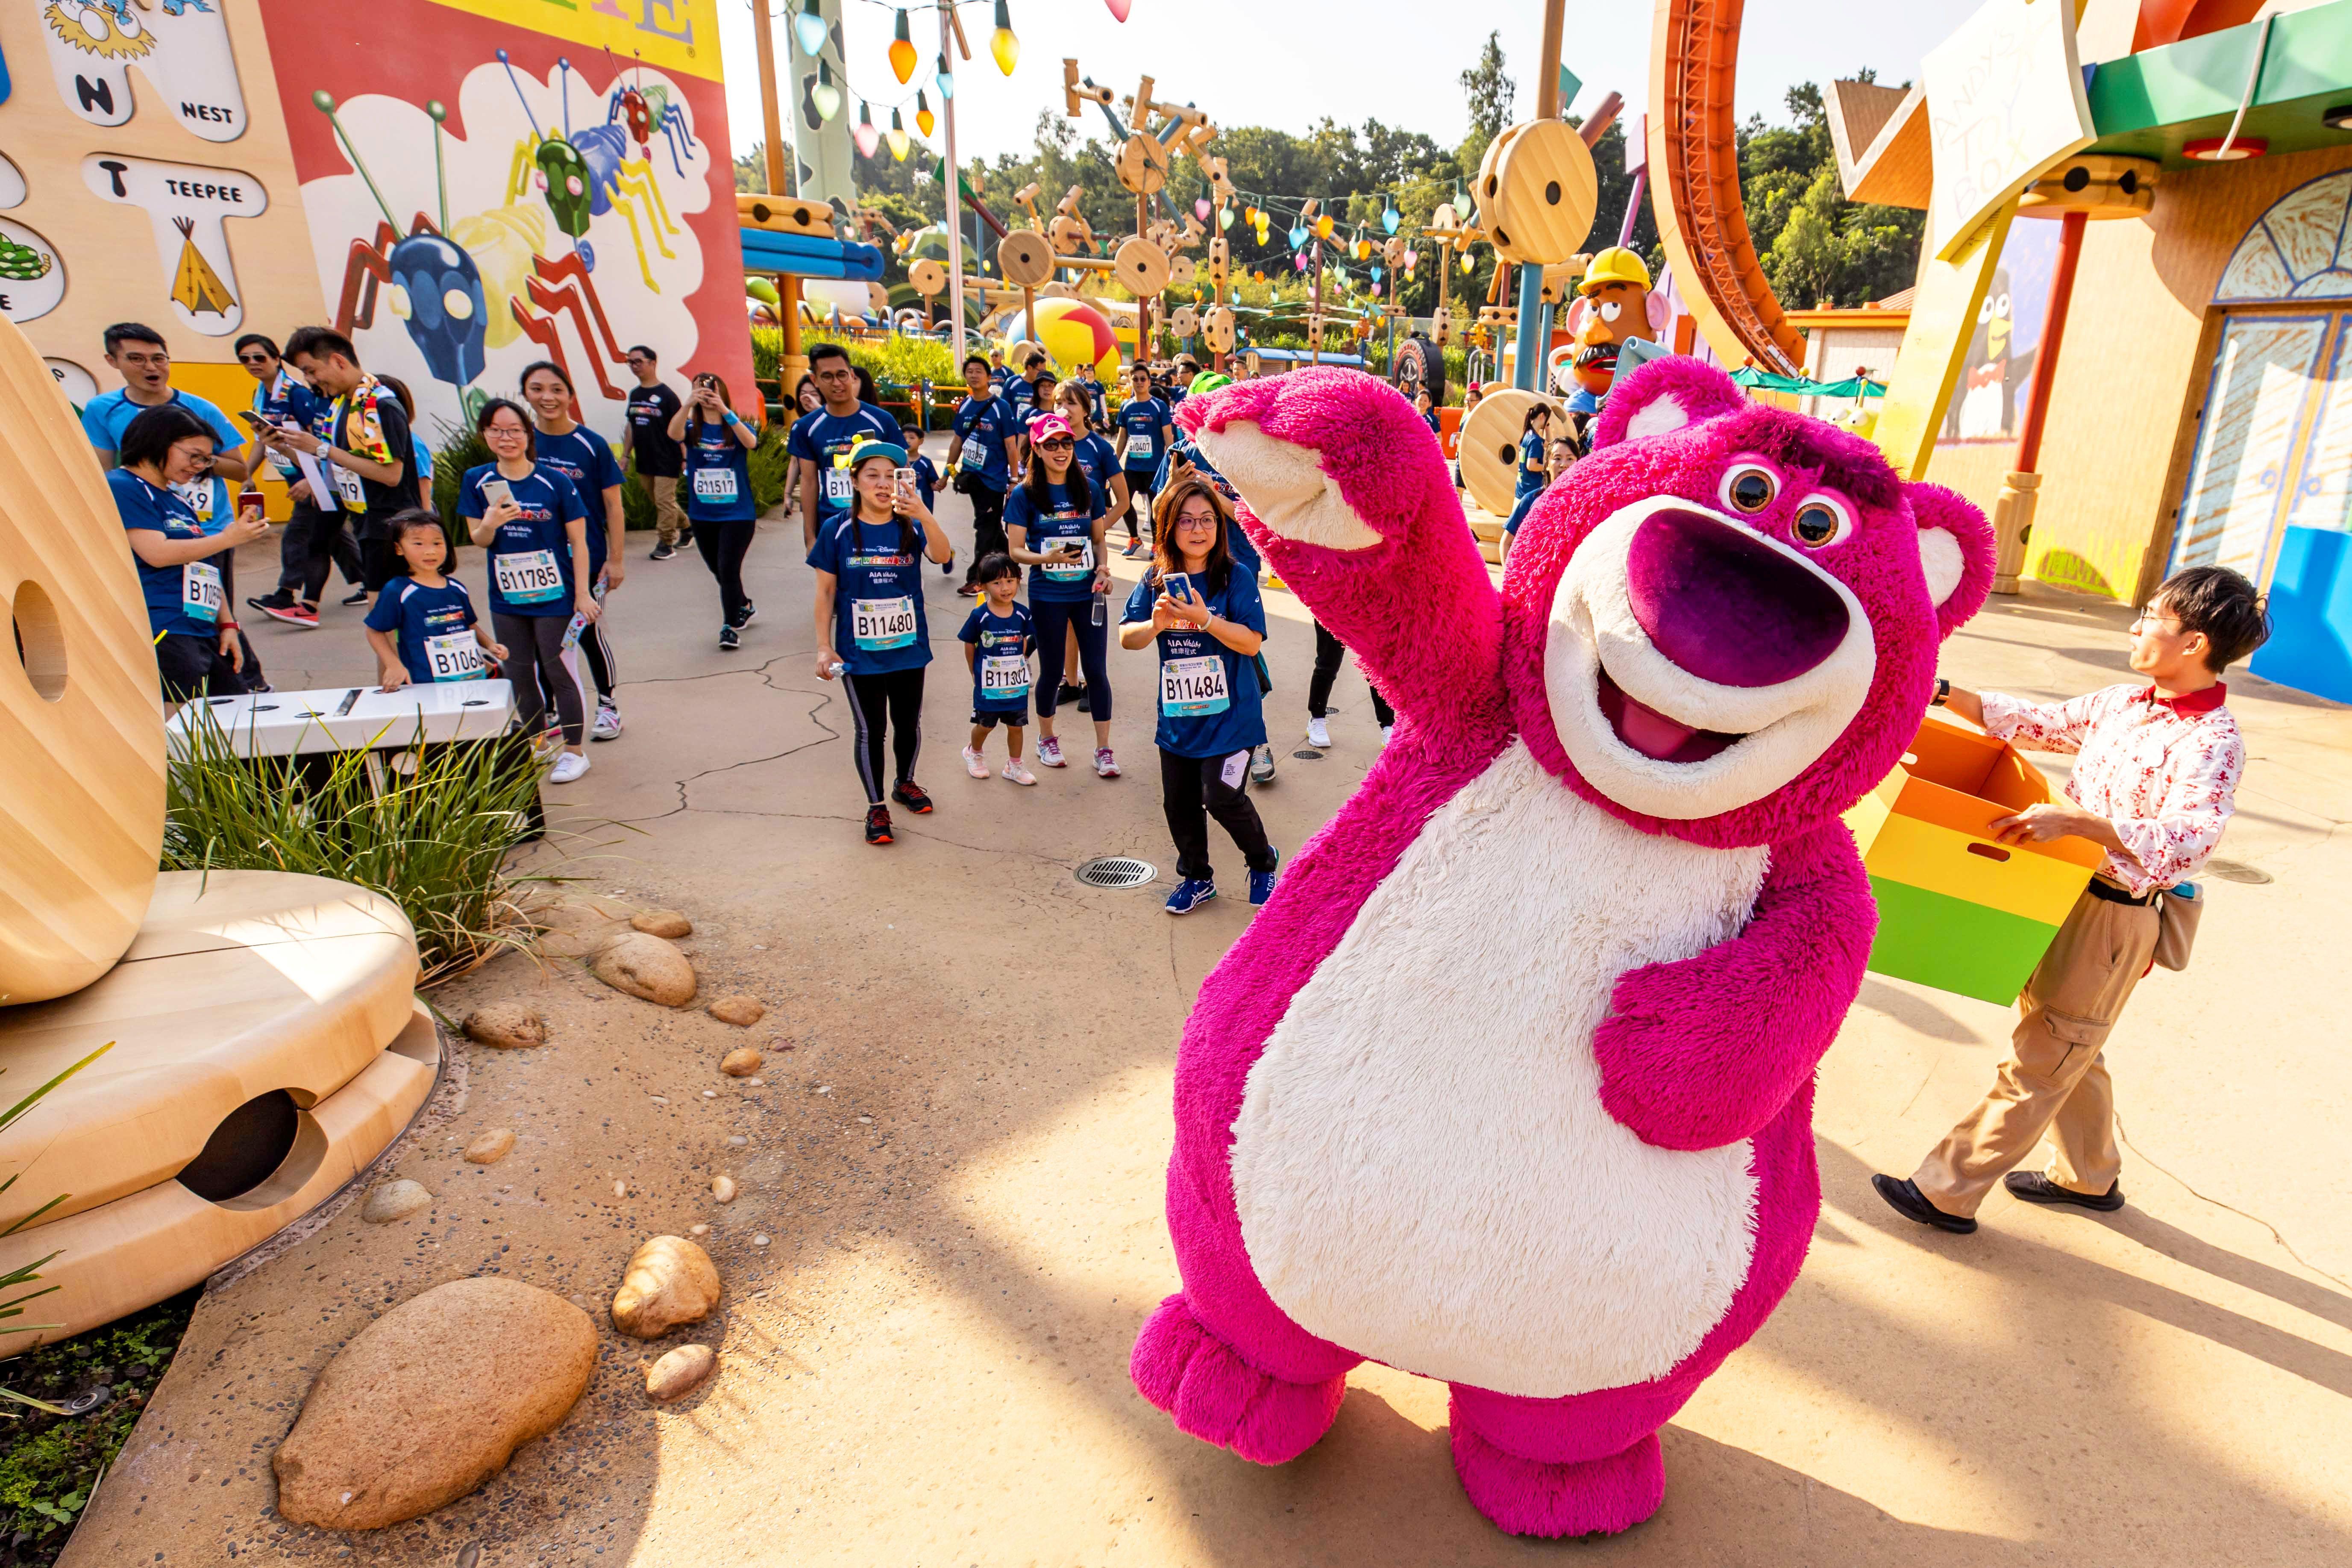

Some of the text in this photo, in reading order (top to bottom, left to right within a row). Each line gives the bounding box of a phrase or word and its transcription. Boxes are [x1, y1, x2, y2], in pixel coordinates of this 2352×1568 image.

[75, 74, 113, 115] N
[181, 102, 232, 123] NEST
[99, 161, 128, 197] T
[1953, 126, 2029, 220] BOX
[165, 179, 242, 203] TEEPEE
[697, 480, 733, 493] B11517
[499, 566, 557, 590] B11785
[858, 613, 913, 636] B11480
[1183, 639, 1201, 649] Vitality
[986, 667, 1029, 687] B11302
[1166, 674, 1224, 700] B11484
